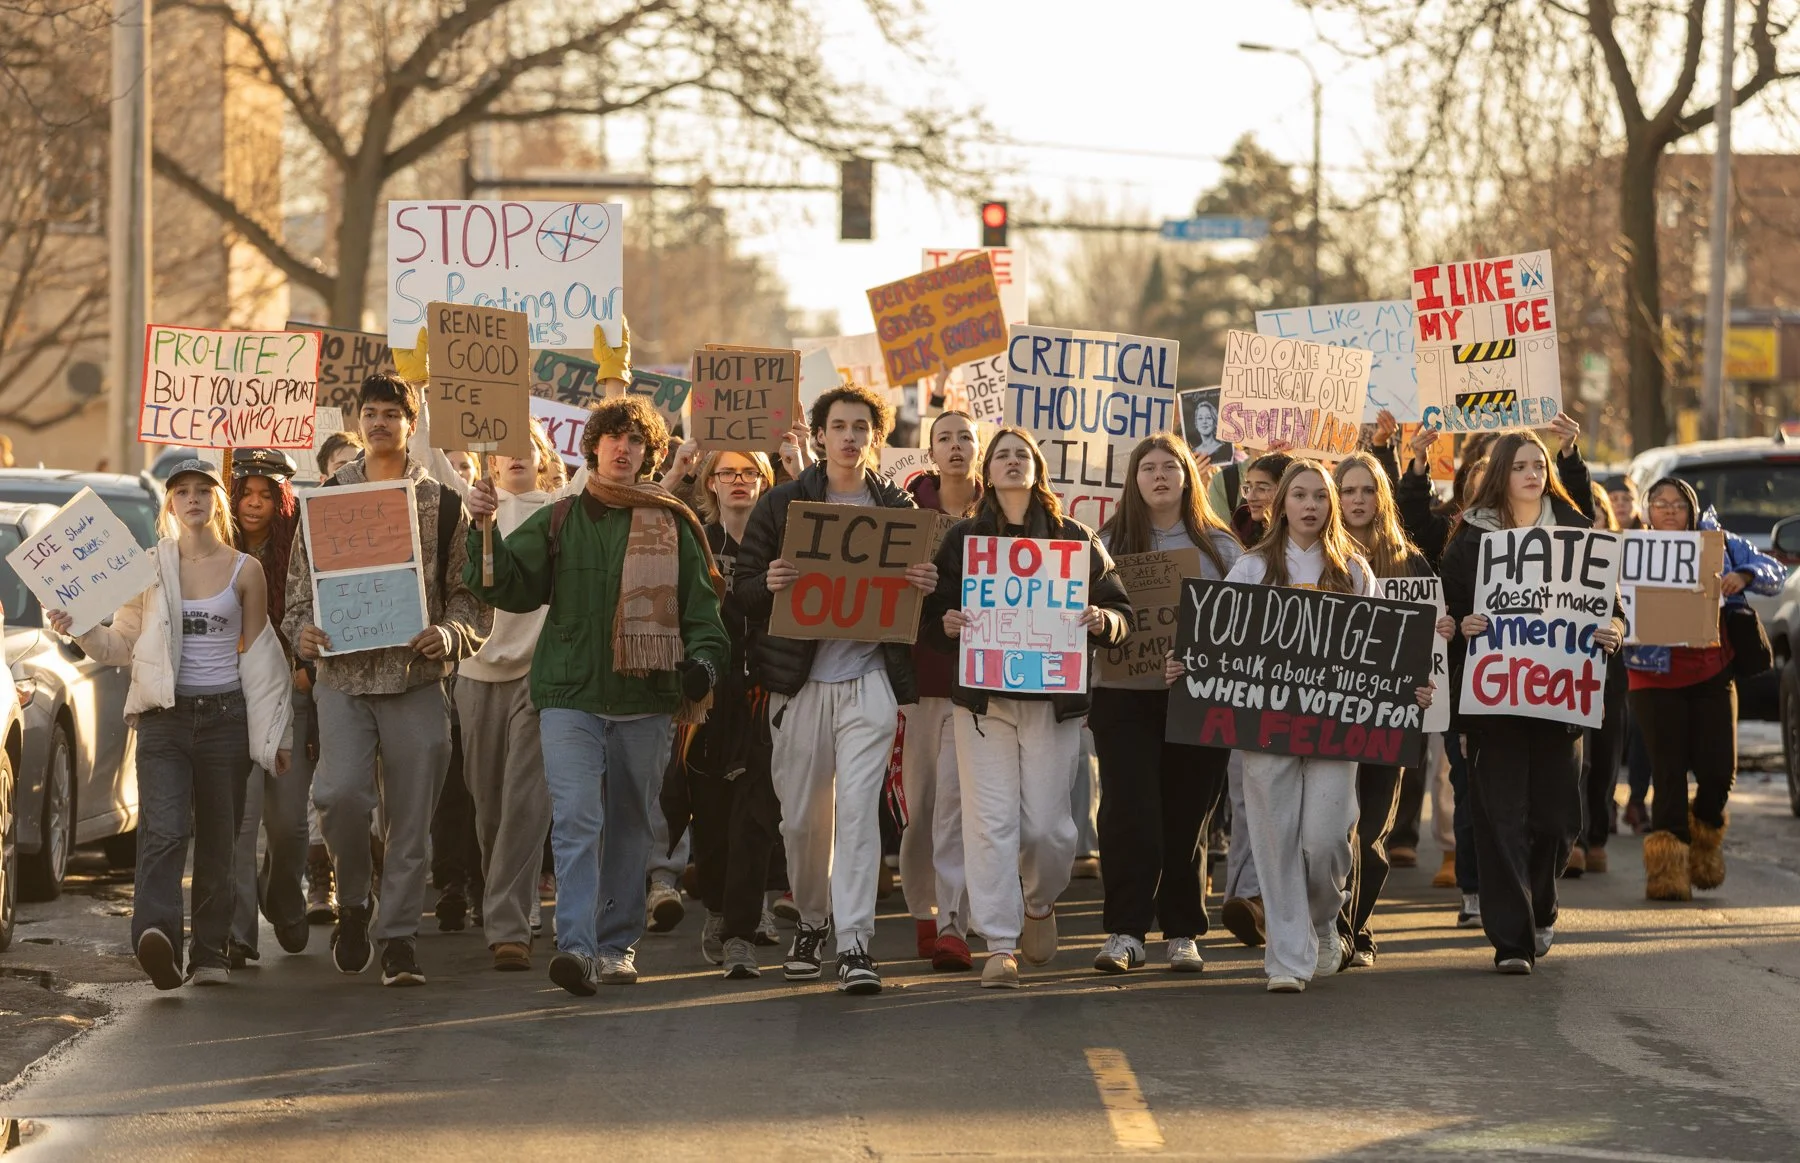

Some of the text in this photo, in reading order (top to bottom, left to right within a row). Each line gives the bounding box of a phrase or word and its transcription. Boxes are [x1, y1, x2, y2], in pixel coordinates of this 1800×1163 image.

[564, 281, 624, 321] Our
[870, 257, 993, 313] DEPORTATION
[1414, 259, 1516, 312] I LIKE
[440, 308, 508, 341] RENEE
[878, 303, 936, 342] GIVES
[1262, 312, 1299, 338] I
[1418, 298, 1552, 342] MY ICE
[447, 338, 518, 376] GOOD
[696, 355, 748, 382] HOT
[754, 357, 793, 384] PPL
[887, 332, 940, 381] DICK
[1008, 335, 1175, 390] CRITICAL
[1228, 331, 1267, 365] NO
[1271, 339, 1320, 371] ONE
[1326, 345, 1363, 379] IS
[154, 369, 205, 405] BUT
[210, 375, 242, 406] YOU
[245, 377, 317, 407] SUPPORT
[440, 382, 483, 405] ICE
[713, 388, 772, 412] MELT
[1224, 366, 1316, 403] ILLEGAL
[1318, 377, 1358, 414] ON
[229, 405, 276, 443] WHO
[460, 412, 508, 441] BAD
[703, 416, 769, 441] ICE
[1007, 383, 1174, 438] THOUGHT
[1221, 402, 1359, 456] STOLEN LAND
[1422, 396, 1558, 432] CRUSHED
[322, 500, 388, 530] FUCK
[23, 534, 63, 571] ICE
[795, 511, 917, 569] ICE
[967, 536, 1083, 579] HOT
[1483, 527, 1618, 590] HATE
[1131, 566, 1157, 579] SAFE
[1163, 563, 1179, 575] AT
[1622, 538, 1697, 584] OUR
[41, 575, 55, 587] in
[55, 576, 86, 607] NOT
[335, 578, 387, 598] ICE
[790, 572, 911, 629] OUT
[962, 576, 1085, 611] PEOPLE
[1125, 575, 1172, 590] SCHOOLS
[1385, 578, 1439, 602] ABOUT
[1485, 582, 1553, 614] doesn't
[1556, 591, 1609, 617] make
[962, 608, 1082, 650] MELT
[1188, 583, 1253, 646] YOU
[1340, 601, 1420, 671] GET
[973, 650, 1067, 689] ICE
[1107, 640, 1135, 666] OF
[1182, 647, 1209, 672] to
[1217, 651, 1267, 680] talk
[1270, 659, 1326, 687] about
[1186, 674, 1420, 729] WHEN U VOTED FOR
[1472, 653, 1602, 717] Great
[1199, 706, 1405, 763] A FELON
